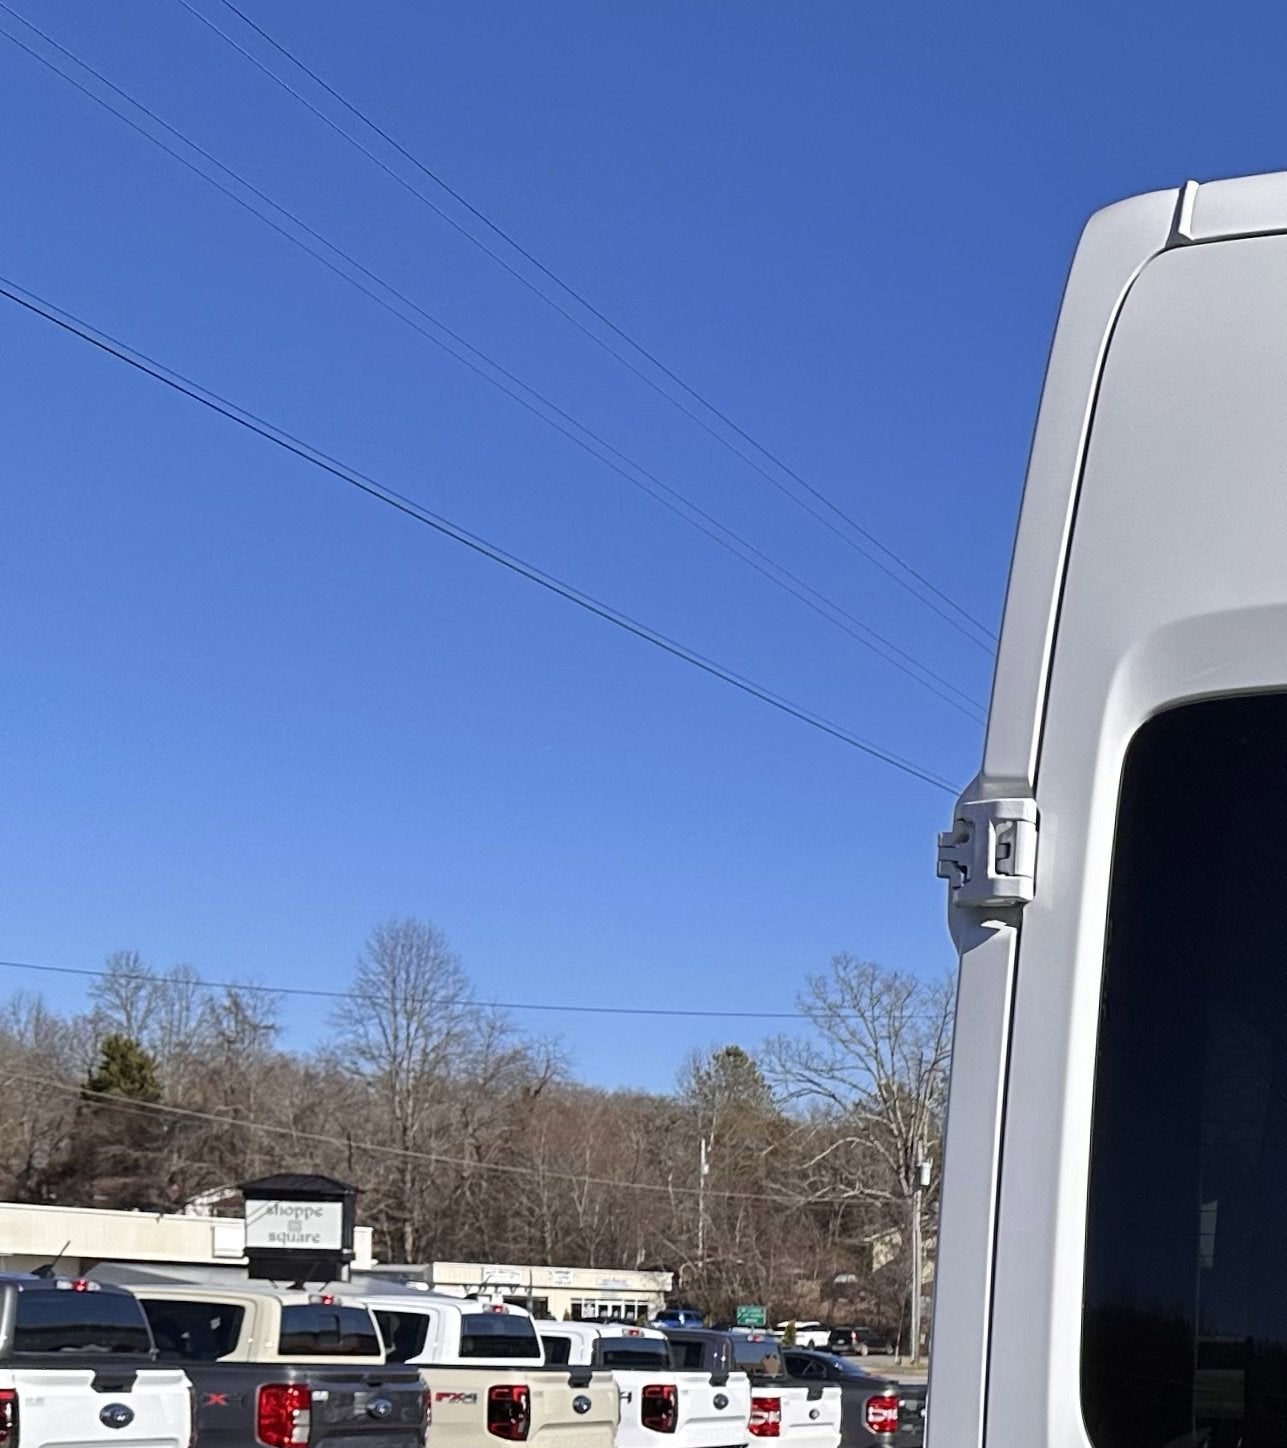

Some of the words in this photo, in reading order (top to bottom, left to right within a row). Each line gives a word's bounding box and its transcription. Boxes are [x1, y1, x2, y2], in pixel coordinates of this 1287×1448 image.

[266, 1203, 323, 1219] shoppe
[268, 1231, 321, 1244] square
[435, 1392, 478, 1404] FX4
